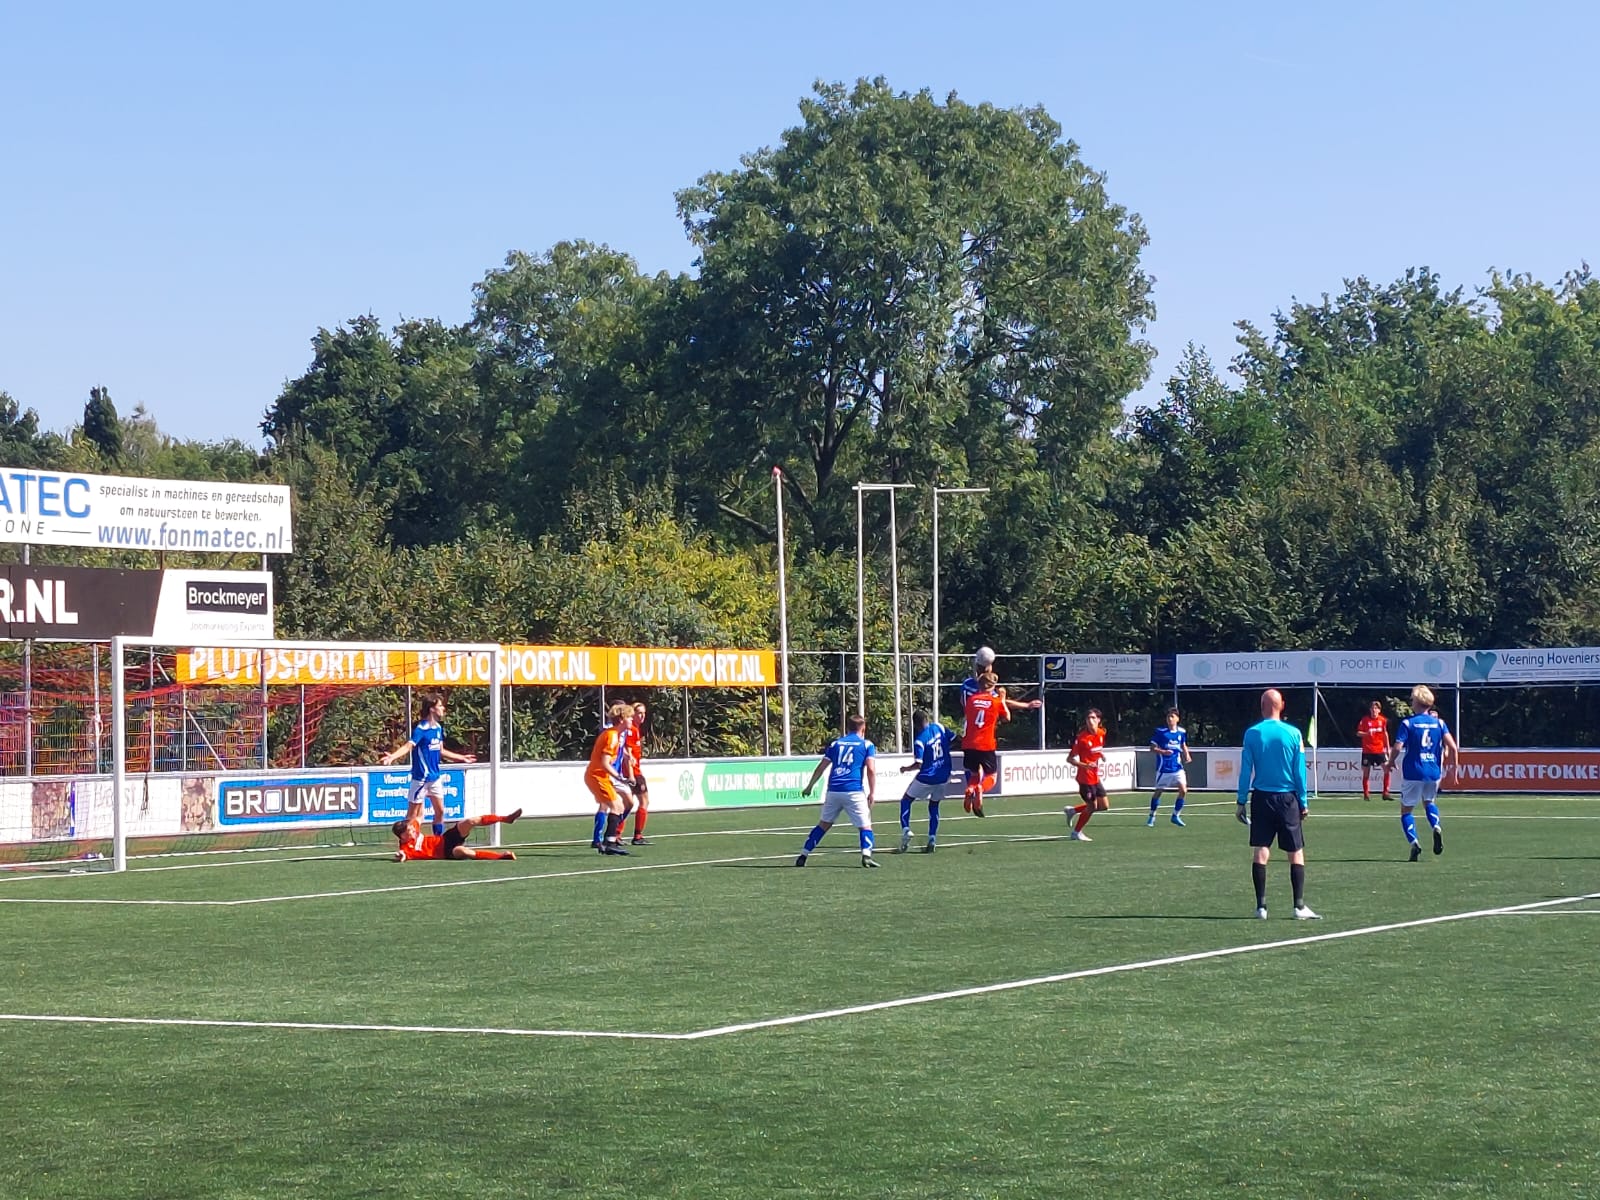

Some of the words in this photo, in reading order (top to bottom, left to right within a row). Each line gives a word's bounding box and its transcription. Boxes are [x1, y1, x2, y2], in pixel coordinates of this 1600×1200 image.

[99, 485, 148, 498] specialist
[151, 486, 161, 498] in
[164, 487, 208, 501] machines
[211, 491, 222, 502] en
[225, 491, 284, 505] gereedschap
[120, 506, 133, 516] om
[137, 507, 197, 520] natuursteen
[201, 508, 211, 519] te
[215, 508, 261, 521] bewerken.
[0, 519, 45, 535] ONE
[98, 522, 283, 549] www.fonmatec.nl
[188, 587, 265, 609] Brockmeyer
[190, 648, 395, 681] PLUTOSPORT.NL
[618, 652, 765, 682] PLUTOSPORT.NL
[1501, 653, 1544, 667] Veening
[1547, 651, 1600, 665] Hoveniers
[974, 709, 985, 728] 4
[1421, 729, 1433, 749] 4
[837, 745, 854, 766] 14
